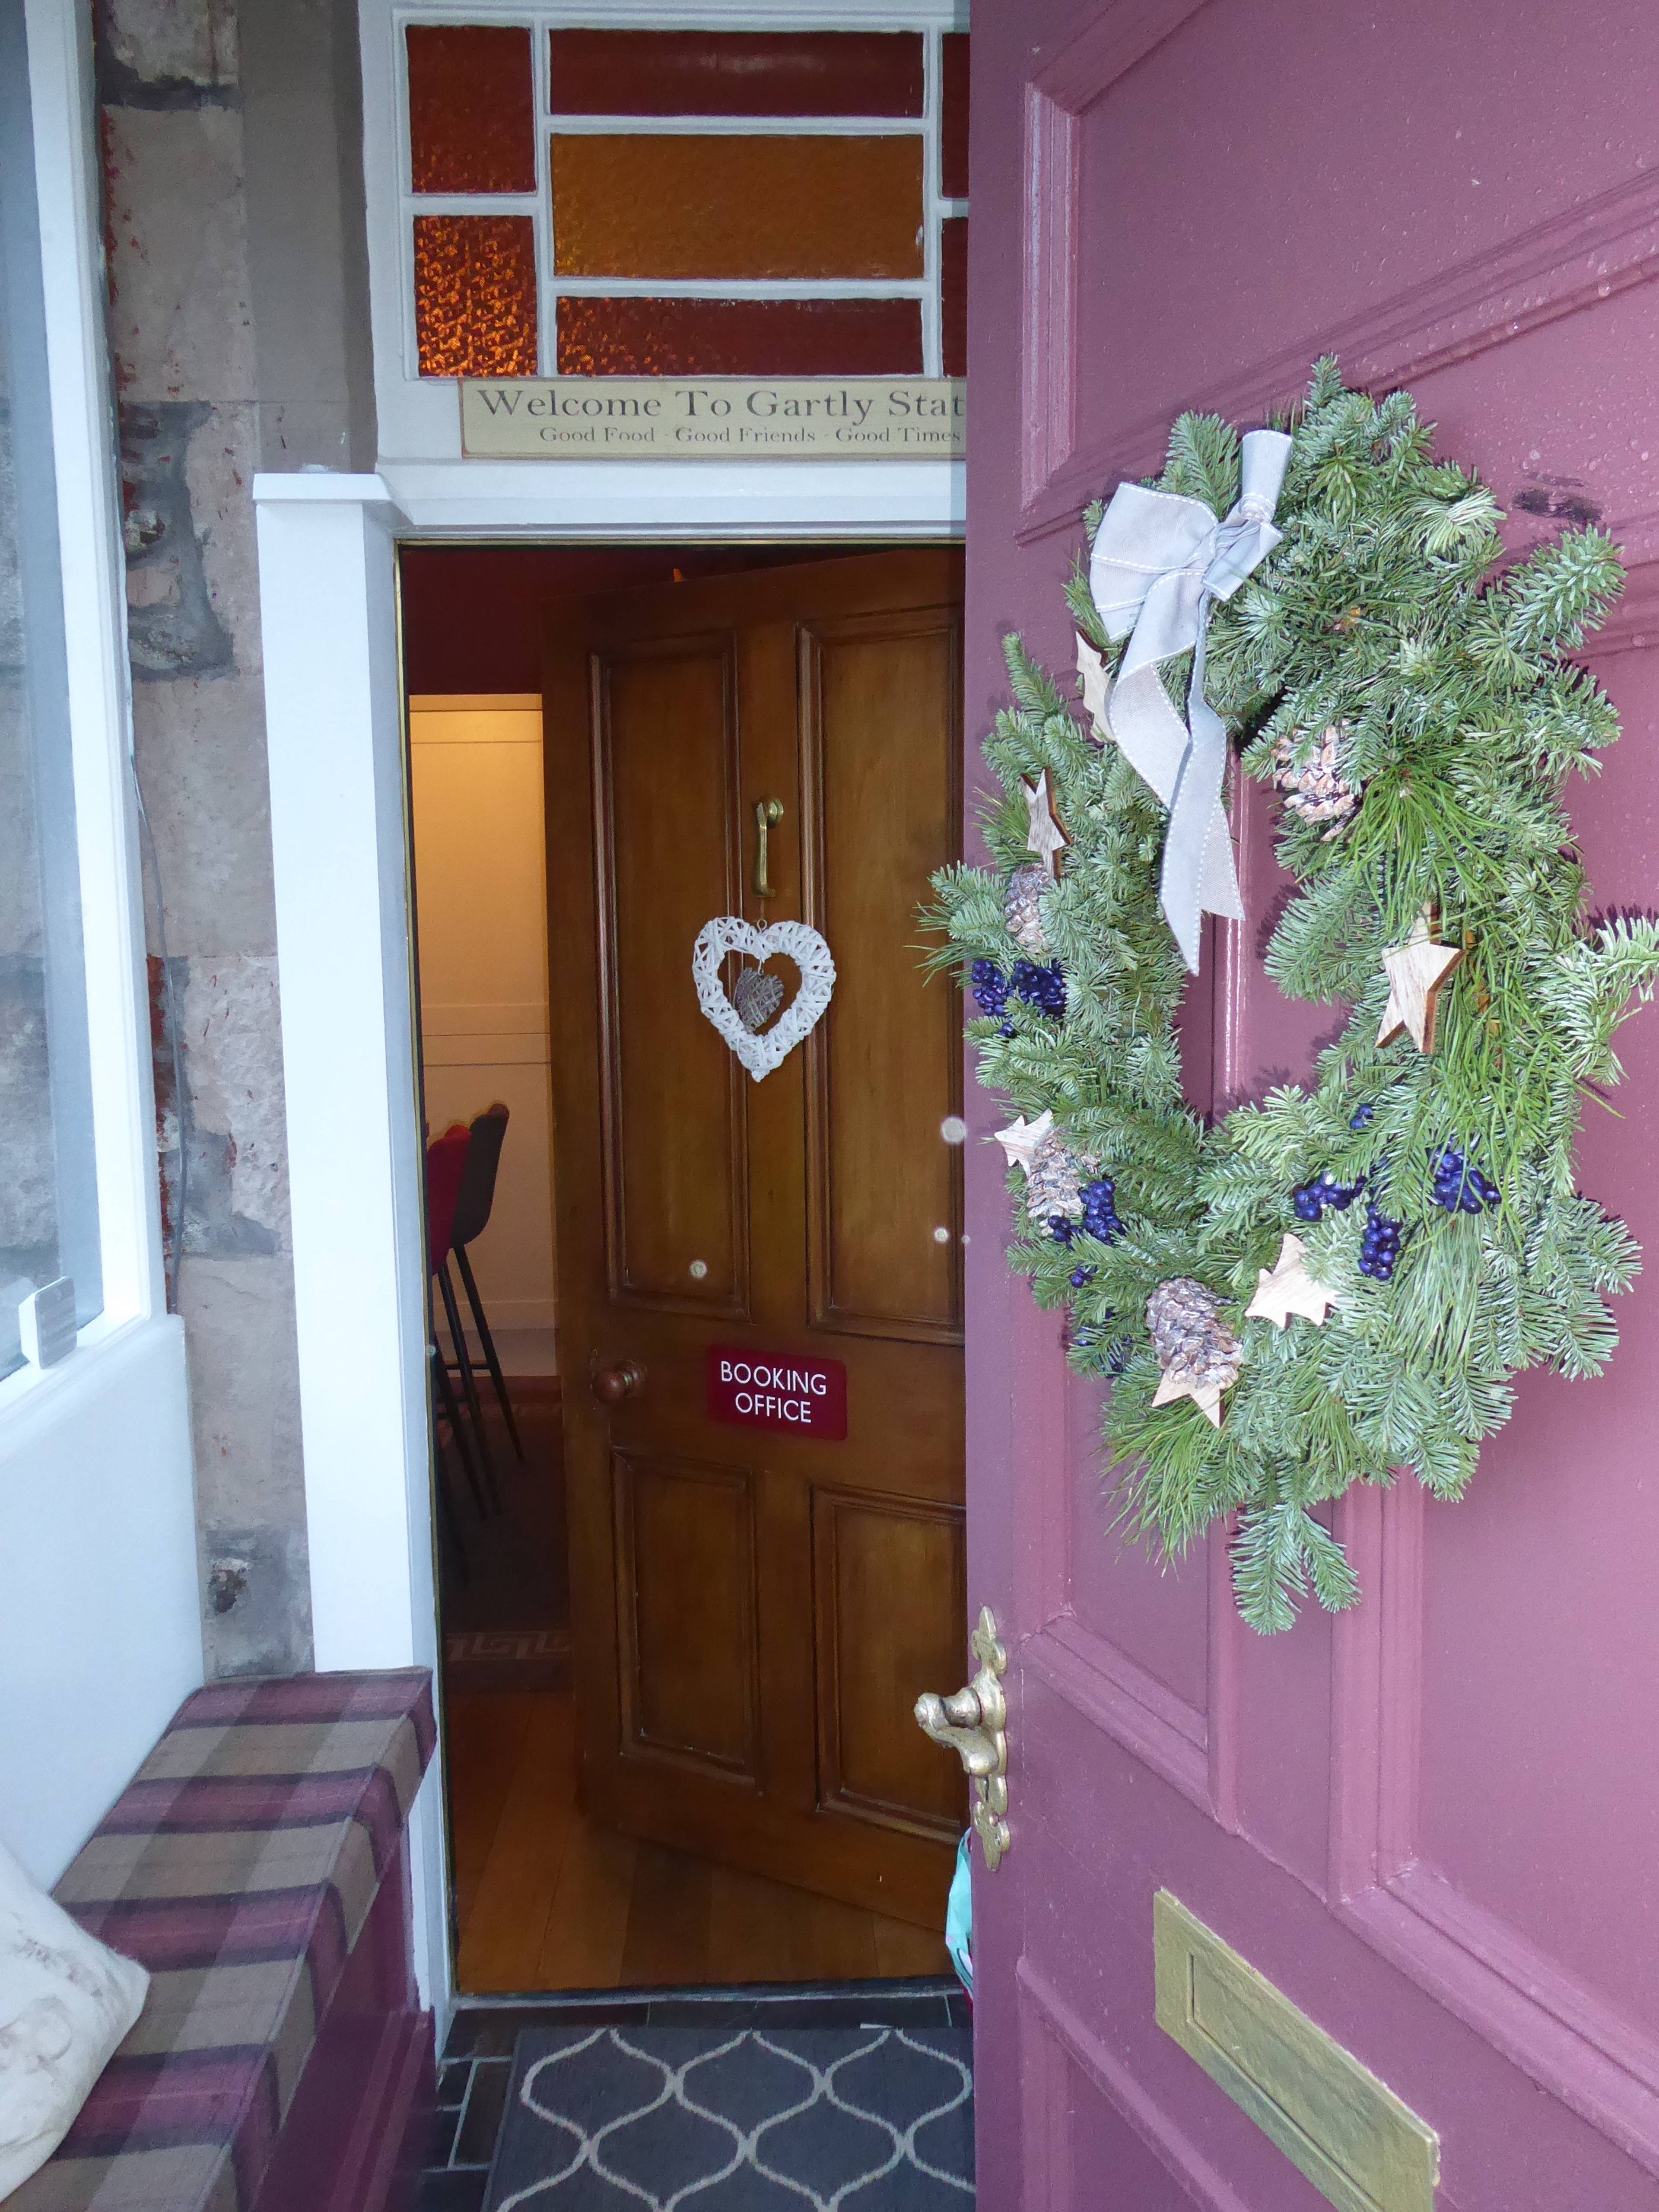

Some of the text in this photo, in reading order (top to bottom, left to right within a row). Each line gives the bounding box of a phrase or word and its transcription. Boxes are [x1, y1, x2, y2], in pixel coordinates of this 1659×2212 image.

[477, 389, 661, 416] Welcome
[675, 390, 731, 416] To
[747, 390, 874, 426] Gartly
[540, 426, 596, 442] Good
[604, 426, 655, 442] Food
[675, 426, 730, 442] Good
[739, 426, 815, 442] Friends
[836, 426, 890, 442] Good
[898, 426, 960, 442] Times
[721, 1360, 826, 1395] BOOKING
[735, 1392, 811, 1423] OFFICE
